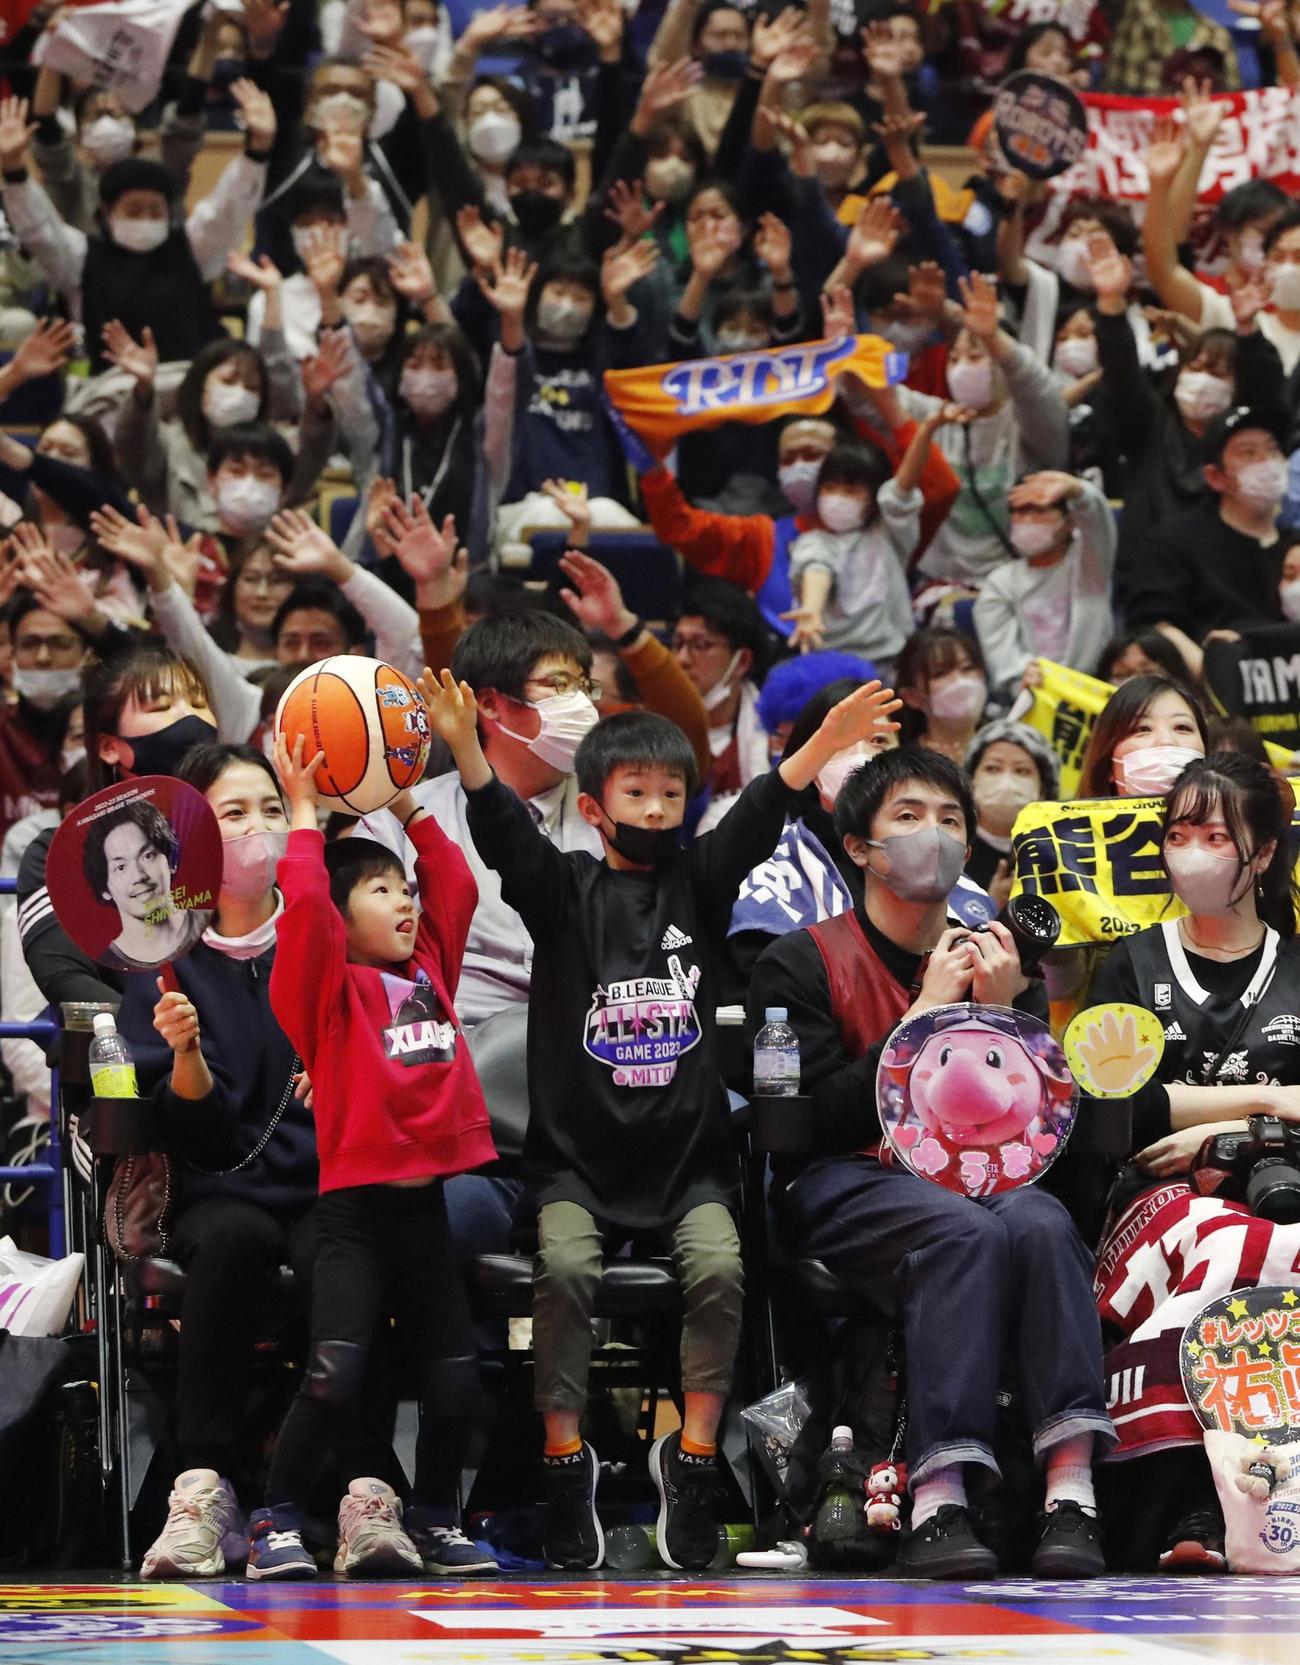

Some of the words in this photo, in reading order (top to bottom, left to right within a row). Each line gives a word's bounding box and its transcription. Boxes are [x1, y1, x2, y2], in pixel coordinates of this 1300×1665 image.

[661, 935, 693, 950] adidas
[612, 981, 676, 1000] B.LEAGUE
[1164, 1033, 1187, 1041] didas
[616, 1045, 652, 1060] GAME
[654, 1041, 681, 1059] 2023
[631, 1067, 672, 1085] MITO
[1195, 1342, 1300, 1434] 祐
[1270, 1517, 1296, 1527] KIRBY
[1268, 1524, 1293, 1543] 30
